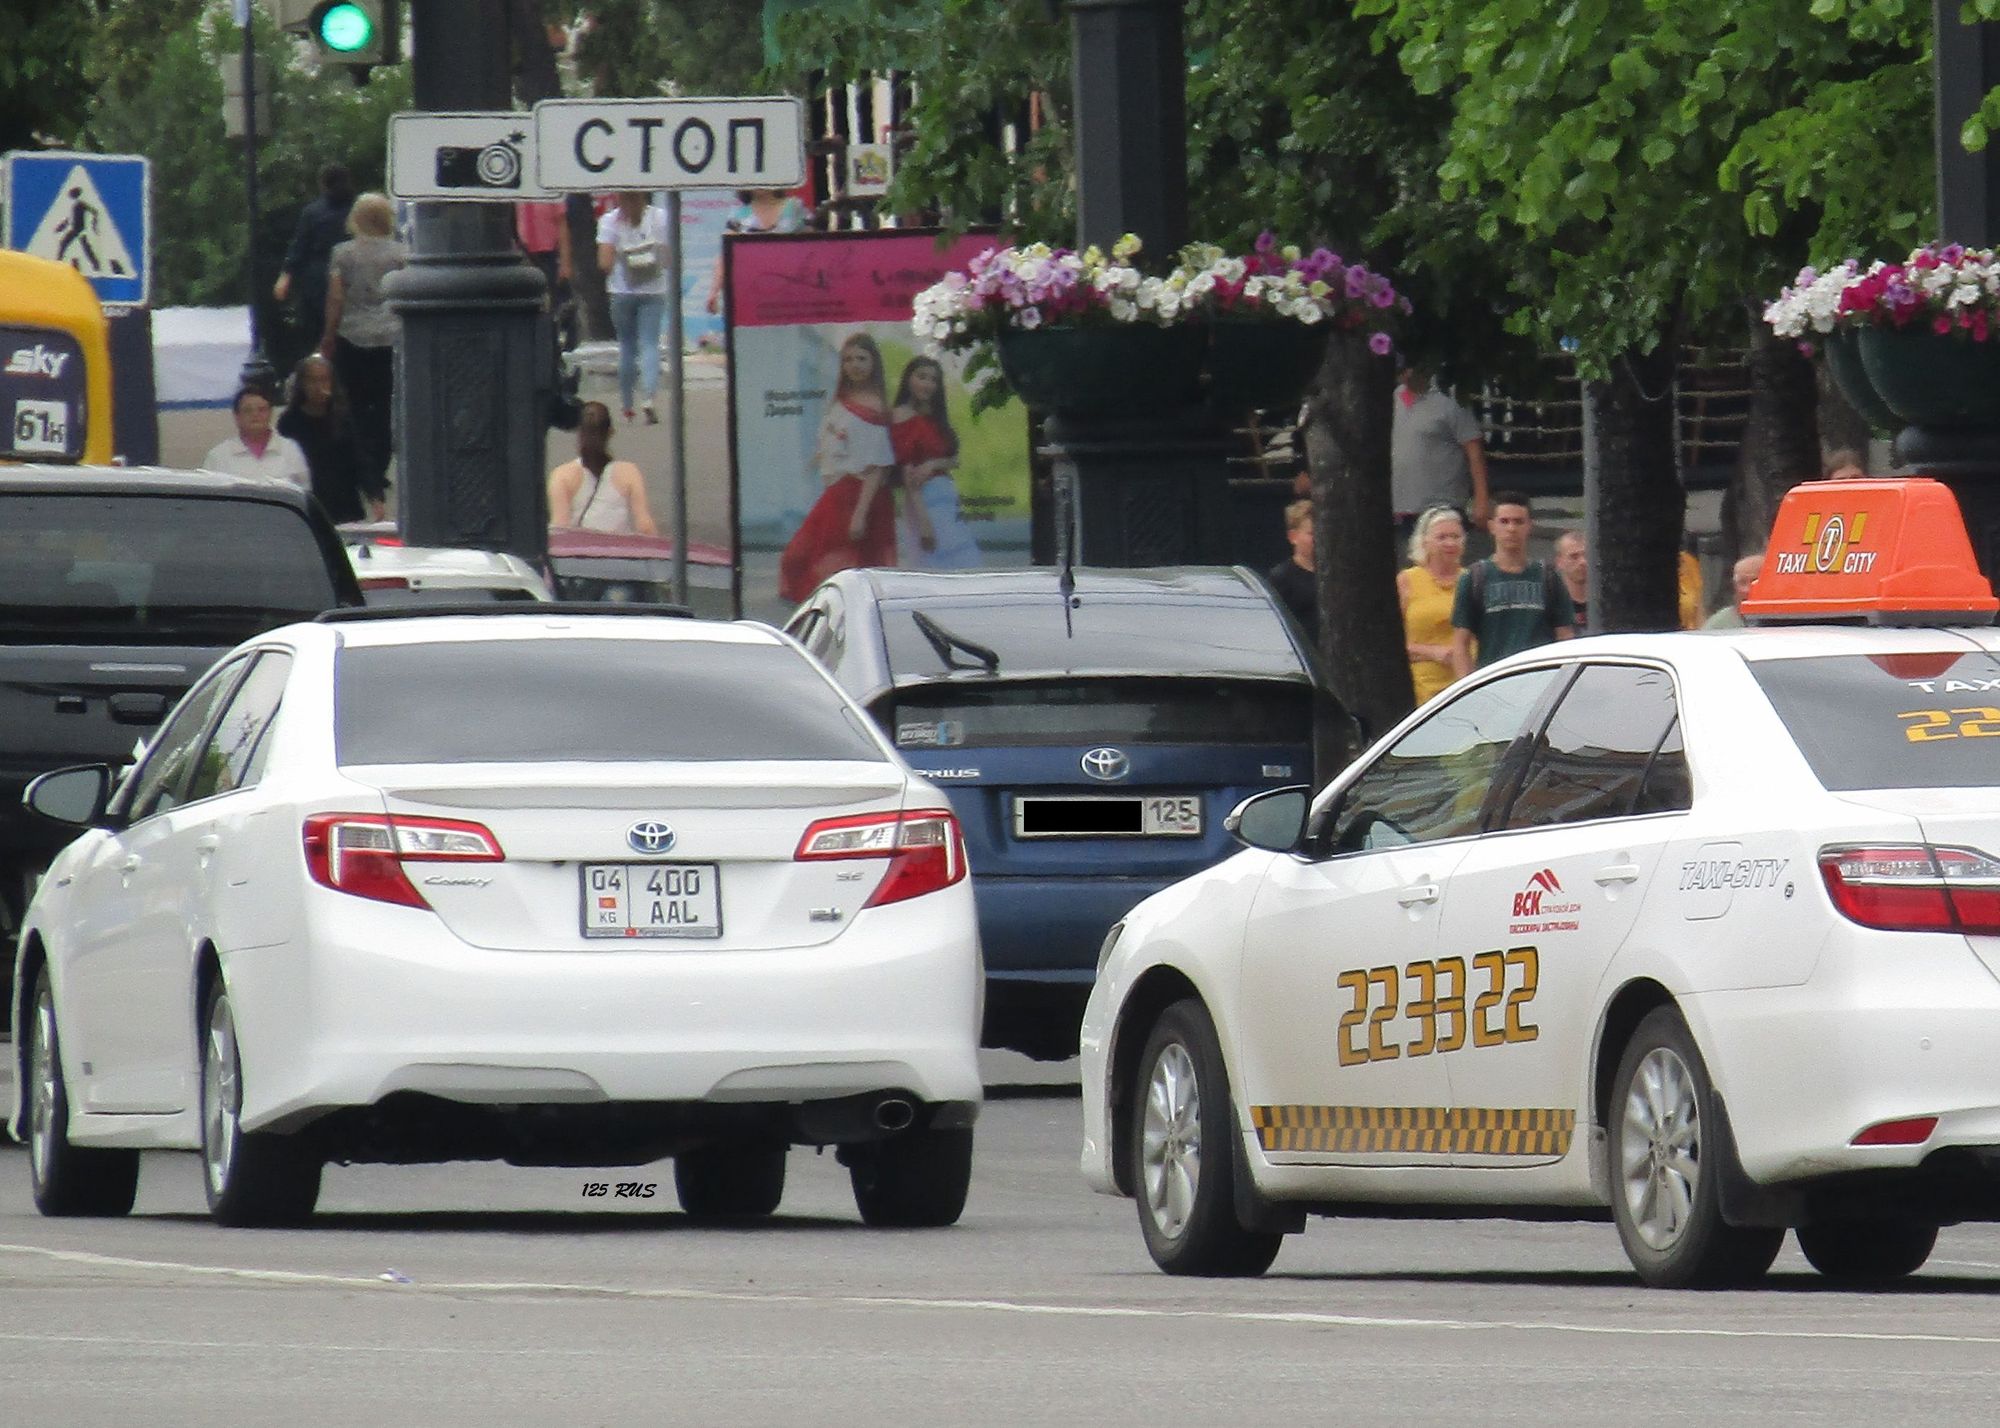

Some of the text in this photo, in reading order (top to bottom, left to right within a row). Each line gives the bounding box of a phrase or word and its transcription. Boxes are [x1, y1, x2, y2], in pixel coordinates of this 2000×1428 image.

[573, 117, 765, 174] СТОП
[1776, 552, 1877, 574] TAXI CITY
[1149, 800, 1193, 822] 125
[592, 869, 700, 896] 04 400
[1679, 858, 1790, 890] TAXI-CITY
[599, 912, 617, 924] KG
[650, 900, 699, 924] AAL
